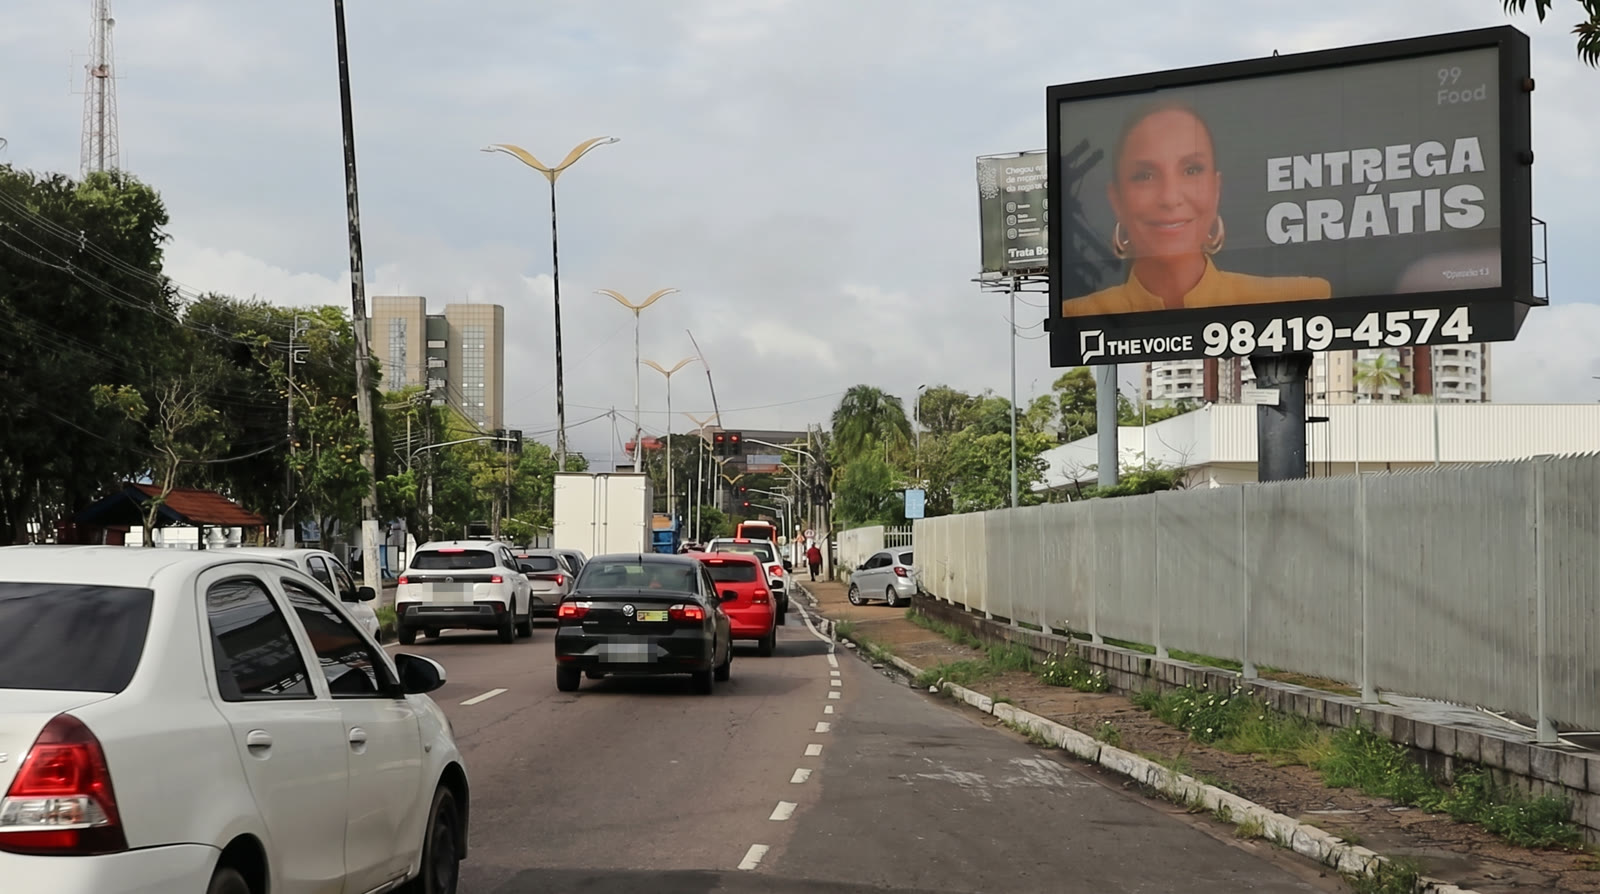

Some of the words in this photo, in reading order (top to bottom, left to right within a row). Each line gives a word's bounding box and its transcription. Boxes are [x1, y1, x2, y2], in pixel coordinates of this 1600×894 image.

[1437, 83, 1487, 105] Food
[1438, 66, 1462, 86] 99
[1266, 136, 1485, 192] ENTREGA
[1265, 184, 1486, 245] GRÁTIS
[1107, 339, 1142, 356] THE
[1142, 335, 1193, 354] VOICE
[1202, 306, 1473, 357] 98419-4574
